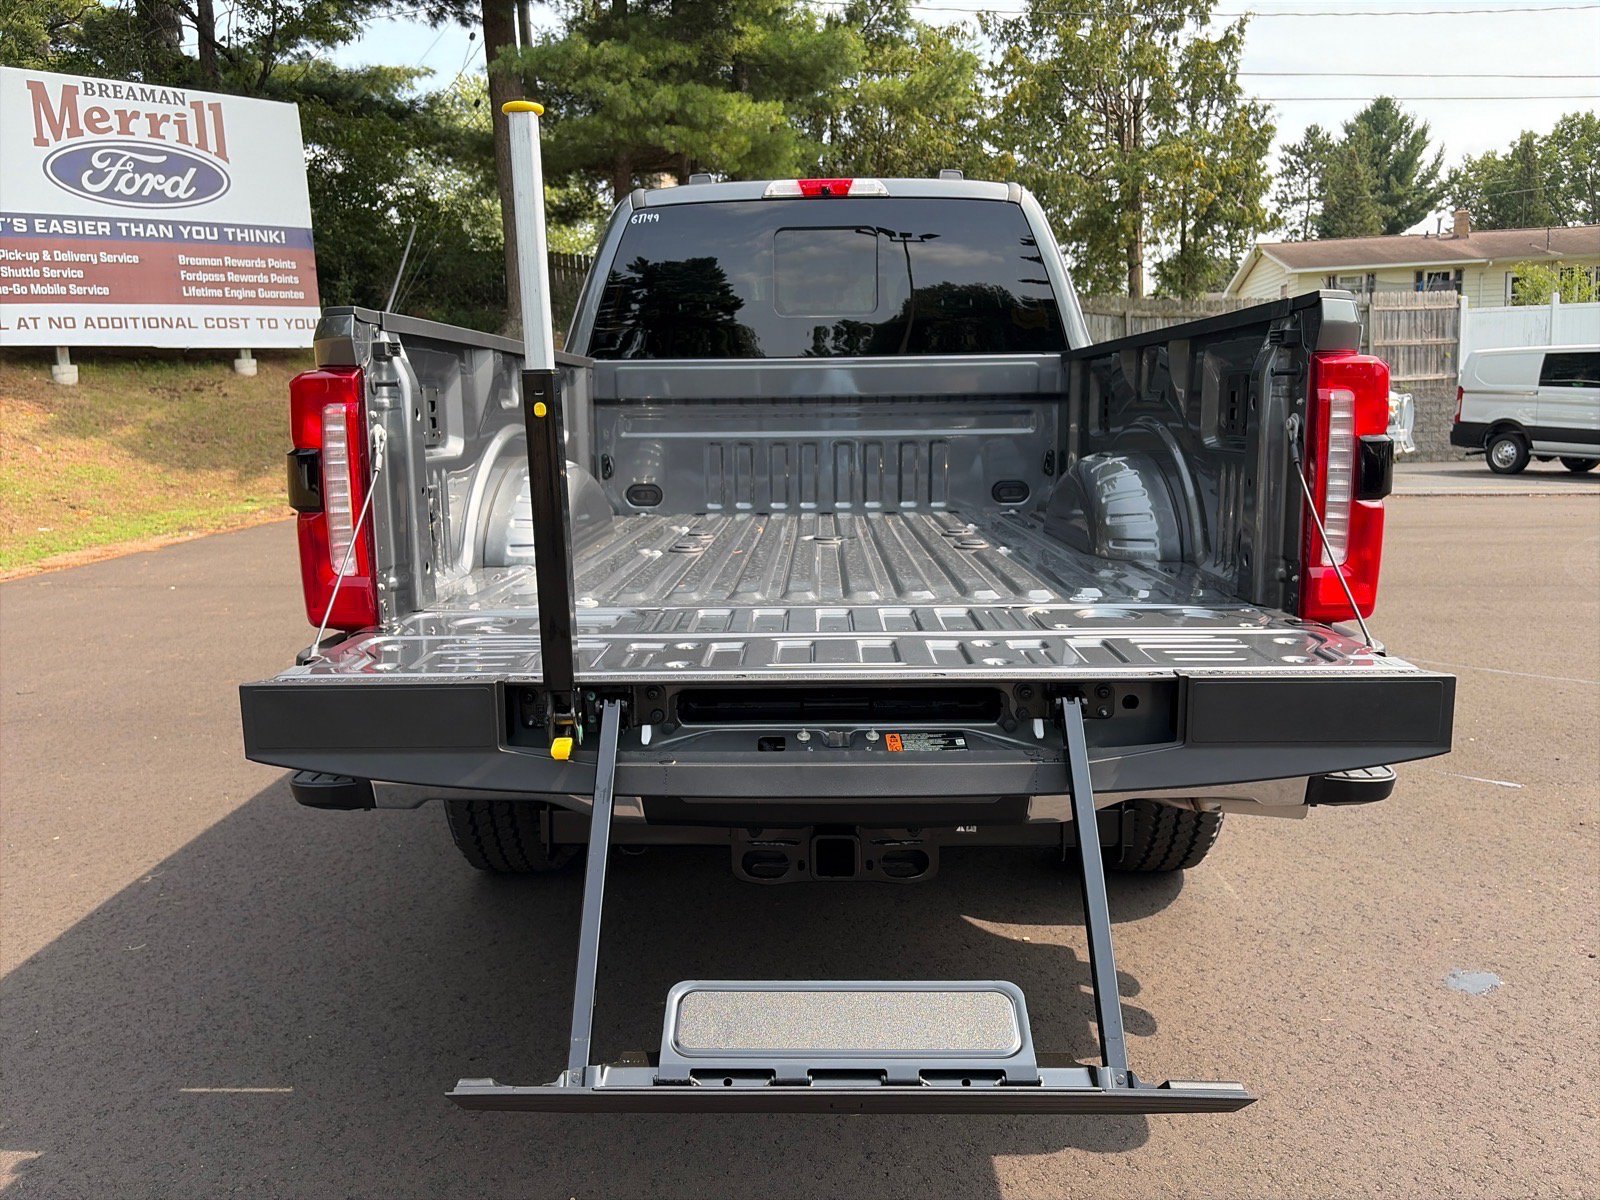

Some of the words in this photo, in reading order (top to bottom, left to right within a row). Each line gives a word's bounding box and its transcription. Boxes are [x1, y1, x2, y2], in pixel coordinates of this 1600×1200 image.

[82, 81, 186, 106] BREAMAN
[26, 79, 229, 164] Merrill
[81, 148, 197, 199] Ford
[34, 219, 111, 235] EASIER
[117, 222, 174, 238] THAN
[179, 225, 219, 240] YOU
[224, 228, 286, 244] THINK!
[42, 250, 52, 261] &
[54, 250, 97, 264] Delivery
[100, 251, 140, 263] Service
[177, 255, 222, 266] Breaman
[224, 256, 266, 268] Rewards
[268, 258, 297, 269] Points
[1, 266, 40, 278] Shuttle
[43, 267, 84, 278] Service
[227, 271, 269, 283] Rewards
[270, 273, 299, 284] Points
[30, 284, 67, 295] Mobile
[69, 284, 110, 295] Service
[182, 286, 222, 298] Lifetime
[224, 287, 257, 300] Engine
[258, 288, 304, 300] Guarantee
[17, 317, 40, 330] AT
[48, 317, 77, 329] NO
[84, 317, 199, 329] ADDITIONAL
[204, 317, 251, 329] COST
[256, 318, 279, 329] TO
[284, 318, 319, 330] YOU
